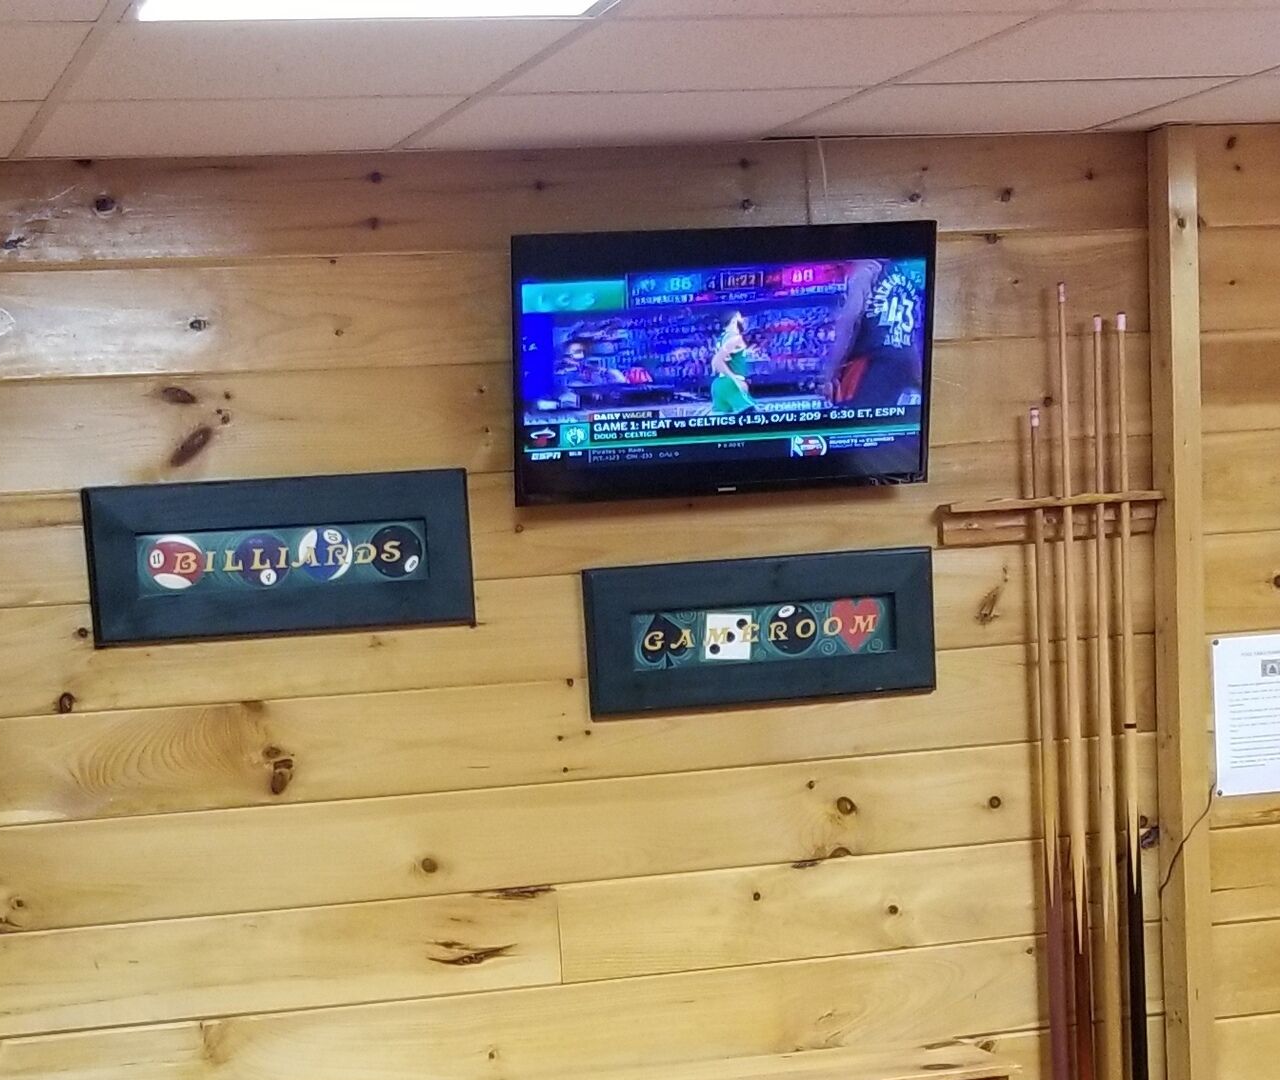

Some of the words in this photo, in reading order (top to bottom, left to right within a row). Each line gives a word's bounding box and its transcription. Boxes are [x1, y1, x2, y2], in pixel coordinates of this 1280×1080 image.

[594, 412, 620, 421] DAILY
[622, 411, 653, 420] WAGER
[594, 422, 628, 432] GAME
[630, 421, 640, 431] 1:
[642, 419, 672, 430] HEAT
[674, 420, 687, 428] vs
[688, 414, 736, 427] CELTICS
[771, 411, 797, 423] O/U:
[799, 411, 821, 422] 209
[830, 409, 855, 420] 6:30
[875, 406, 906, 417] ESPN
[594, 432, 618, 441] DOUG
[625, 430, 658, 439] CELTICS
[531, 451, 562, 461] ESPN
[152, 553, 161, 565] 11
[172, 540, 402, 575] BILLIARDS
[643, 613, 877, 651] GAMEROOM
